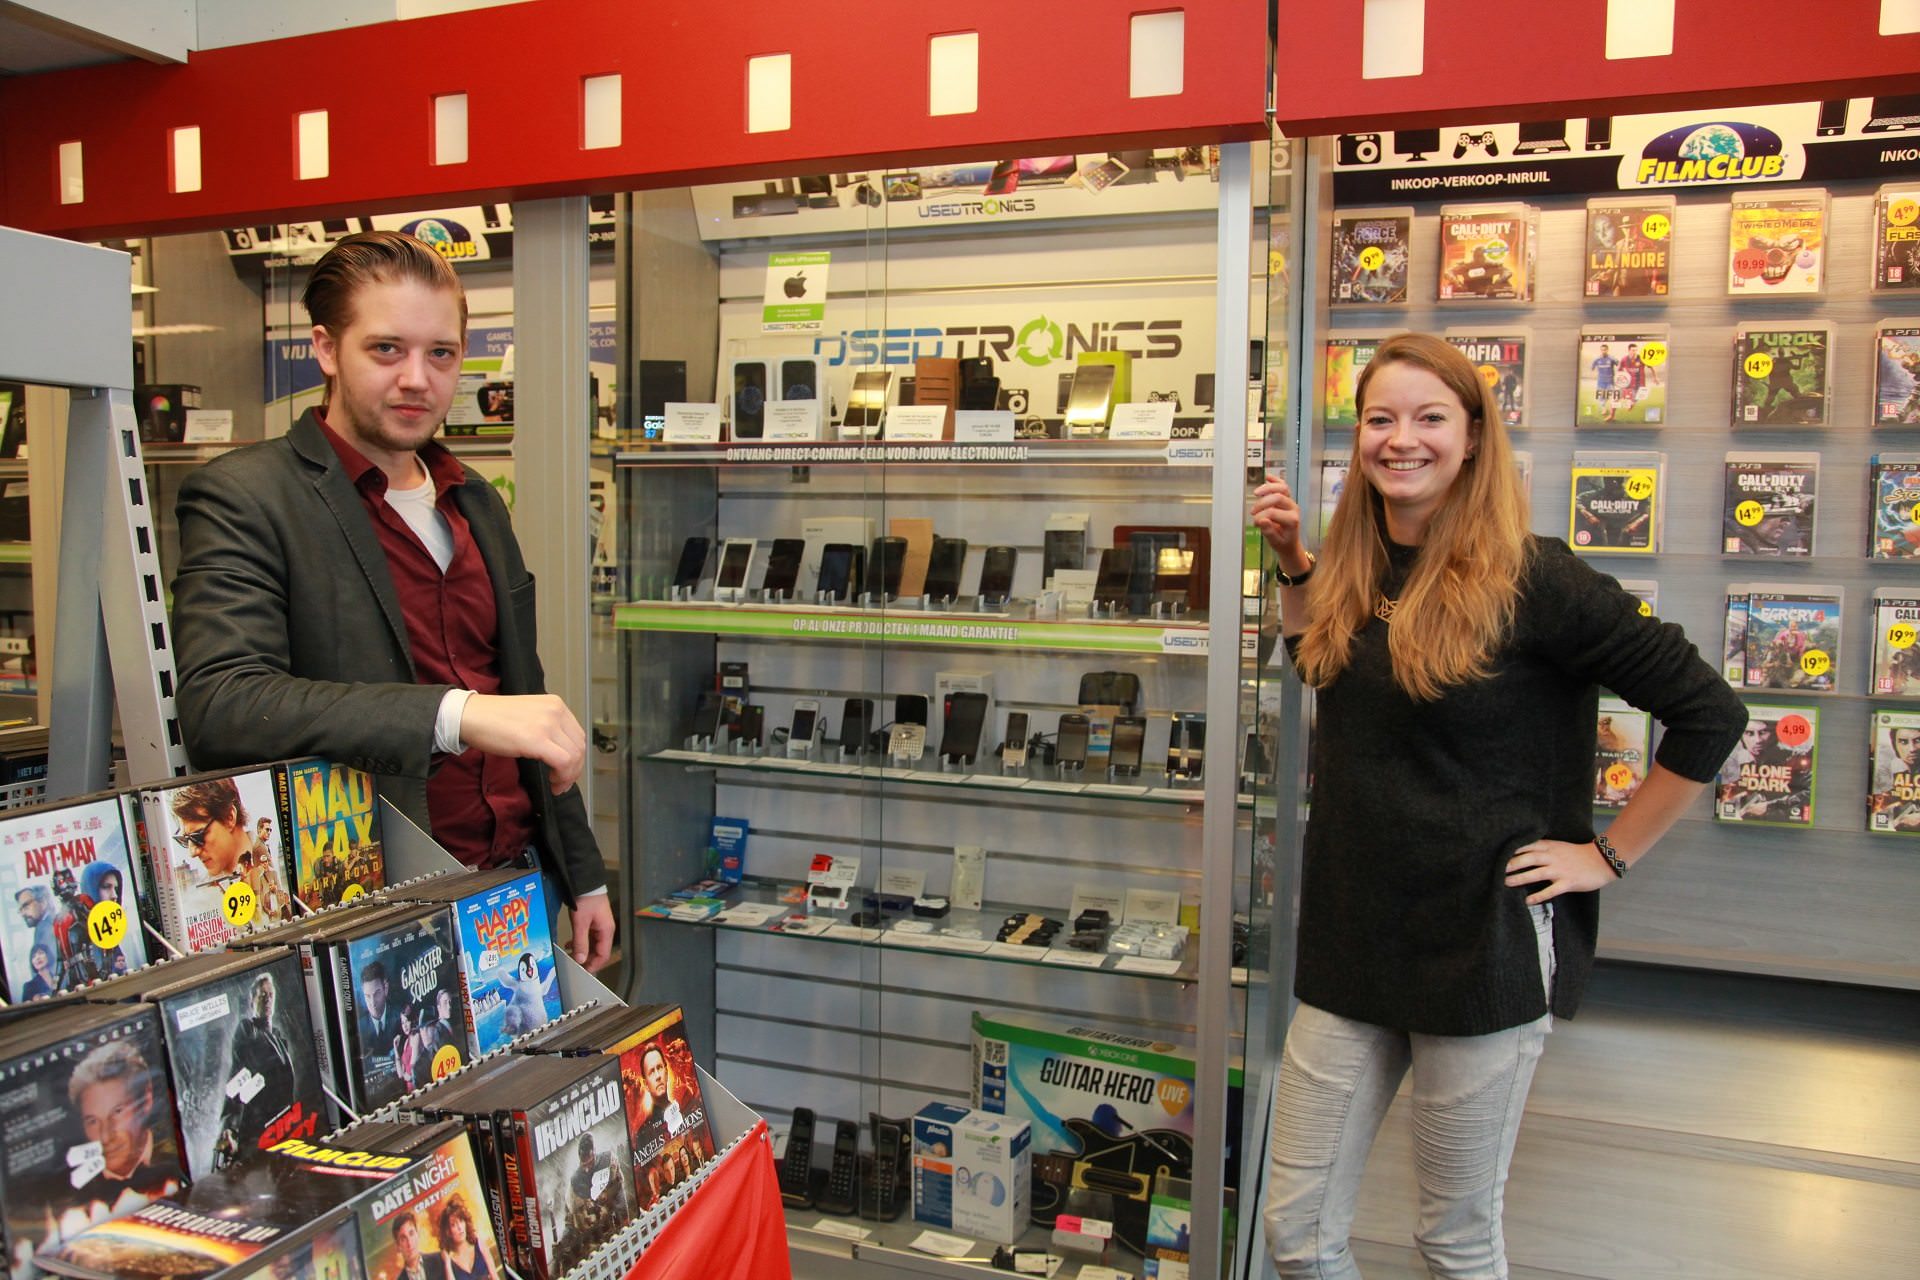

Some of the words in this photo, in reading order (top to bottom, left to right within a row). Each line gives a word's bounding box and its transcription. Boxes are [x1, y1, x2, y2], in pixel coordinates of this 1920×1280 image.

[1636, 155, 1785, 184] FILMCLUB
[1880, 149, 1920, 163] INKO
[1391, 171, 1550, 190] INKOOP-VERKOOP-INRUIL
[1451, 224, 1478, 236] CALL
[1480, 222, 1511, 235] DUTY
[435, 241, 477, 257] CLUB
[1621, 252, 1665, 268] NOIRE
[726, 448, 772, 461] ONTVANG
[774, 448, 808, 461] DIRECT
[811, 448, 859, 460] CONTANT
[887, 447, 918, 460] VOOR
[919, 447, 949, 460] JOUW
[951, 446, 1028, 460] ELECTRONICA!
[1738, 474, 1767, 487] CALL
[1770, 475, 1805, 487] DUTY
[1590, 500, 1612, 510] CALL
[1614, 500, 1640, 511] DUTY
[849, 621, 910, 635] PRODUCTEN
[919, 624, 958, 638] MAAND
[961, 625, 1018, 640] GARANTIE!
[1741, 764, 1792, 779] ALONE
[1748, 778, 1791, 793] DARK
[294, 767, 373, 829] MAD
[24, 837, 96, 878] ANT-MAN
[299, 812, 373, 881] MAX
[304, 875, 337, 894] FURY
[345, 861, 379, 880] ROAD
[474, 893, 531, 945] HAPPY
[486, 921, 529, 958] FEET
[401, 946, 442, 990] GANGSTER
[410, 970, 438, 1004] SQUAD
[458, 971, 471, 1006] HAPPY
[99, 1021, 144, 1043] GERE
[1041, 1057, 1102, 1095] GUITAR
[1104, 1071, 1155, 1105] HERO
[1161, 1084, 1187, 1104] LIVE
[534, 1080, 620, 1161] IRONCLAD
[265, 1139, 411, 1170] FILMCLUB
[633, 1134, 666, 1167] ANGELS
[372, 1182, 413, 1221] DATE
[413, 1156, 457, 1196] NIGHT
